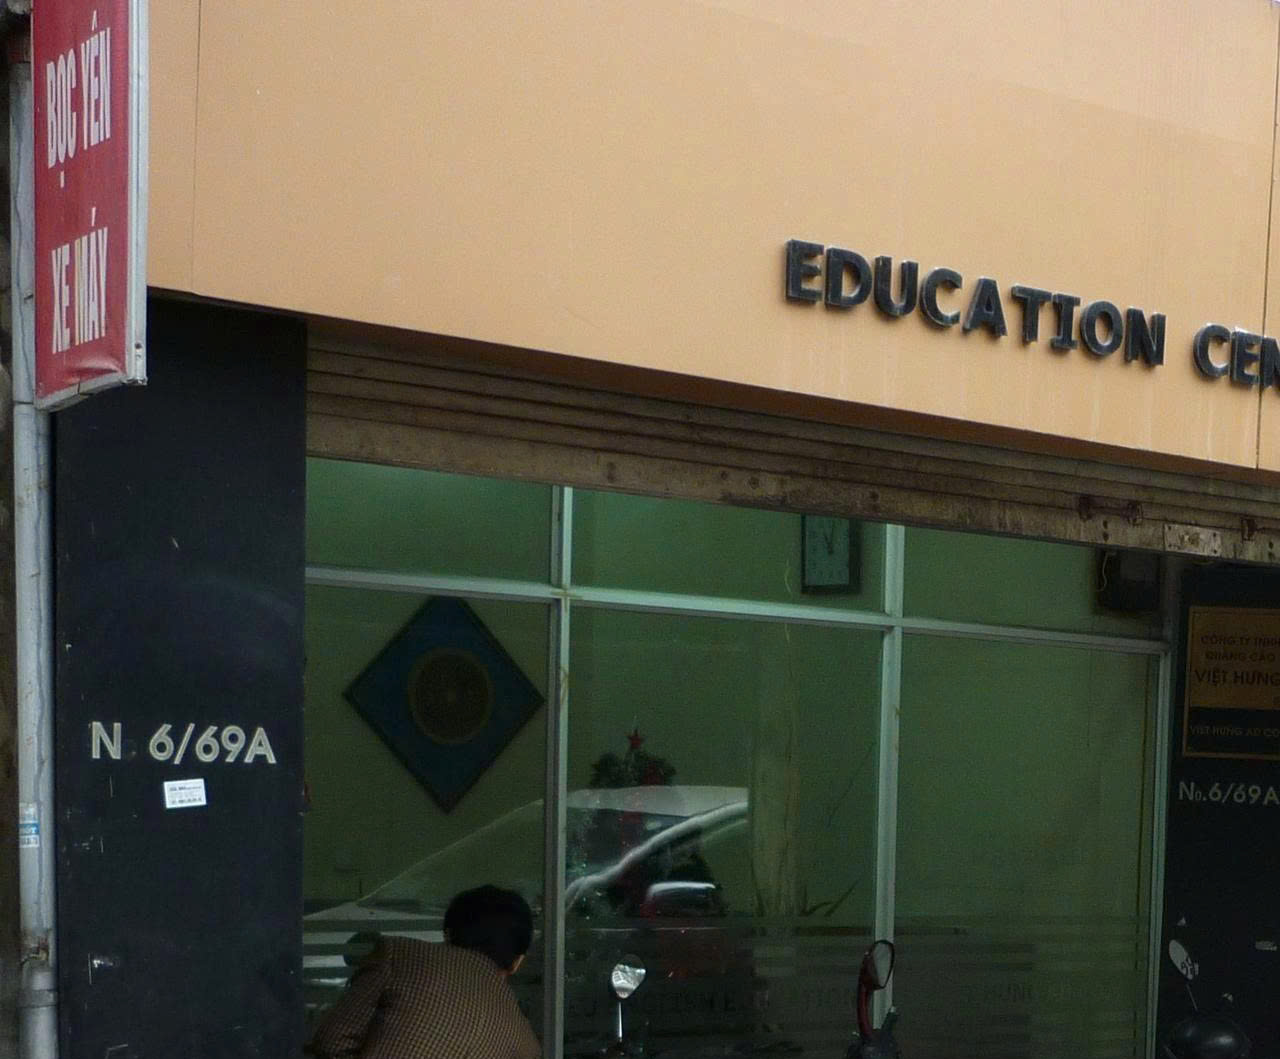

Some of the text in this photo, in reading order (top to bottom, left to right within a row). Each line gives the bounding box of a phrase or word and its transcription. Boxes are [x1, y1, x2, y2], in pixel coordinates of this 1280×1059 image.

[46, 9, 111, 188] BỌC YÊN
[52, 206, 108, 354] XE MÁY
[785, 239, 1167, 366] EDUCATION
[149, 722, 277, 765] 6/69A
